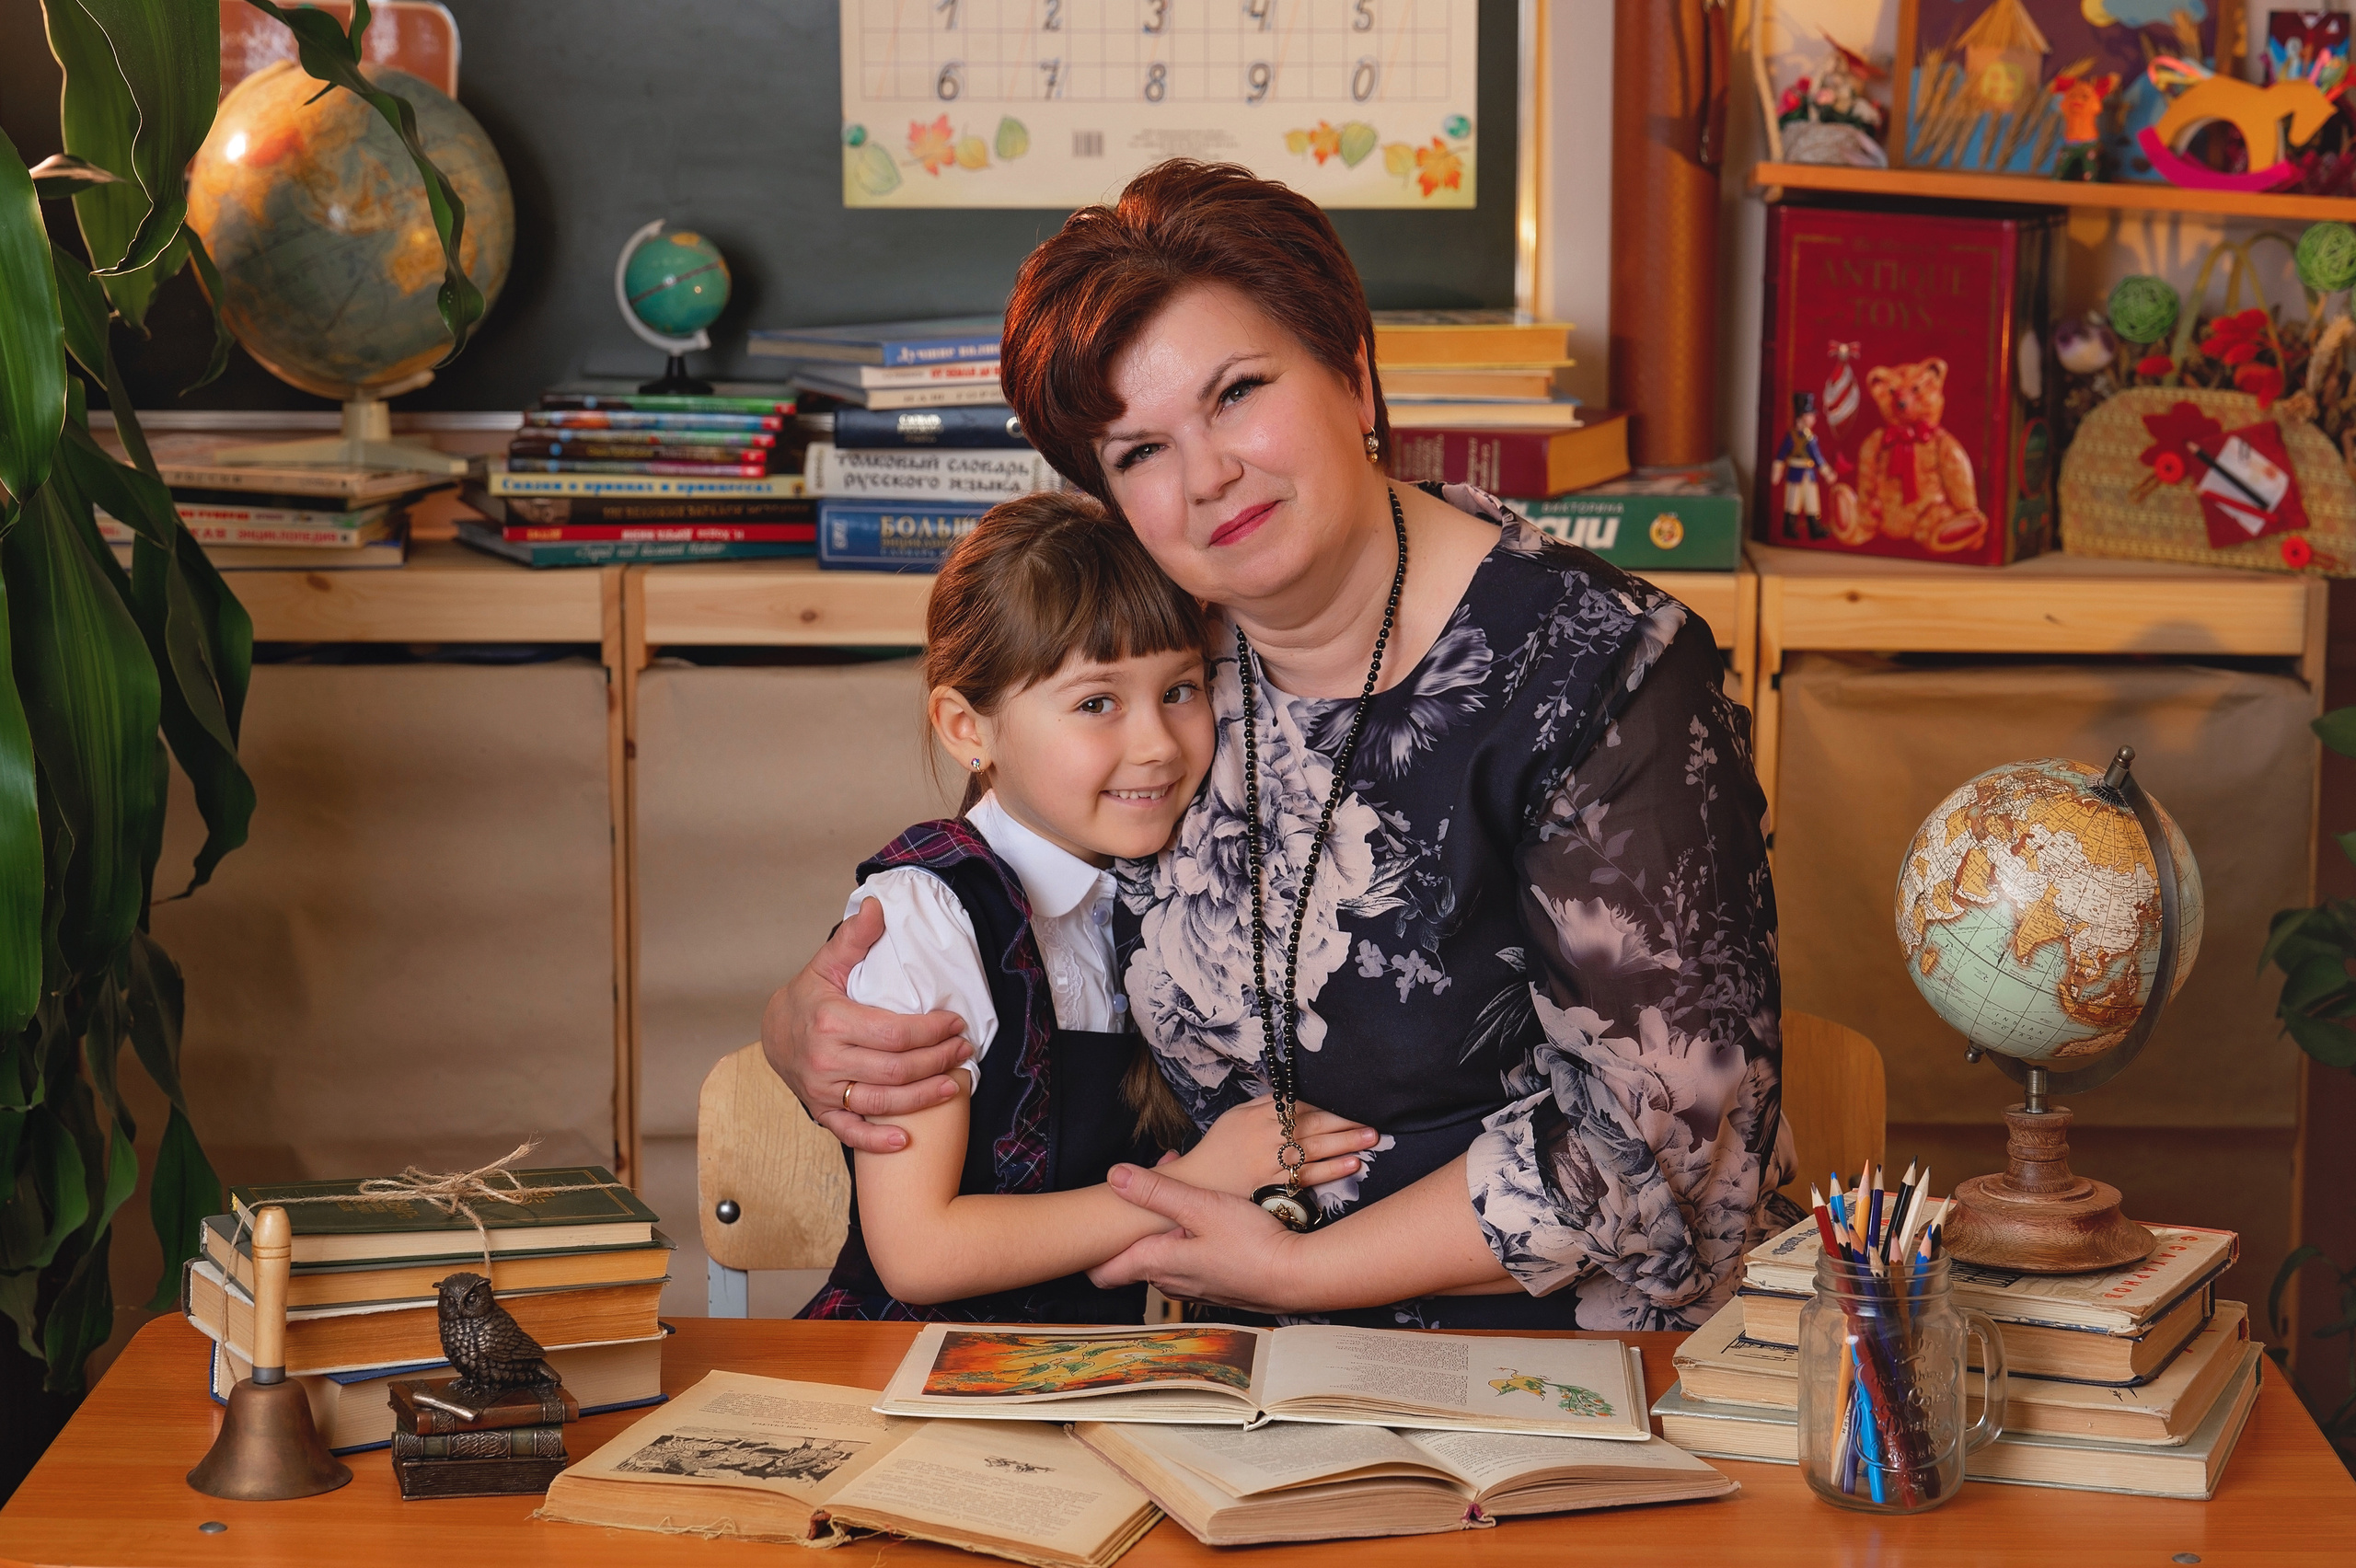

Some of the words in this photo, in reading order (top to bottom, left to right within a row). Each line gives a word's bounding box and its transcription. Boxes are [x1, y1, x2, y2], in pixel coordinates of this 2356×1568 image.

[1043, 0, 1062, 31] 2
[1143, 0, 1167, 33] 3
[1244, 0, 1271, 32] 4
[1352, 0, 1375, 32] 5
[937, 63, 961, 101] 6
[1040, 59, 1063, 100] 7
[1144, 63, 1167, 102] 8
[1245, 63, 1272, 104] 9
[1352, 62, 1377, 102] 0
[1816, 258, 1968, 299] ANTIQUE
[1847, 296, 1934, 332] TOYS
[1542, 502, 1625, 515] ВИКТОРИНА
[2104, 1245, 2187, 1299] САХАРНОВ
